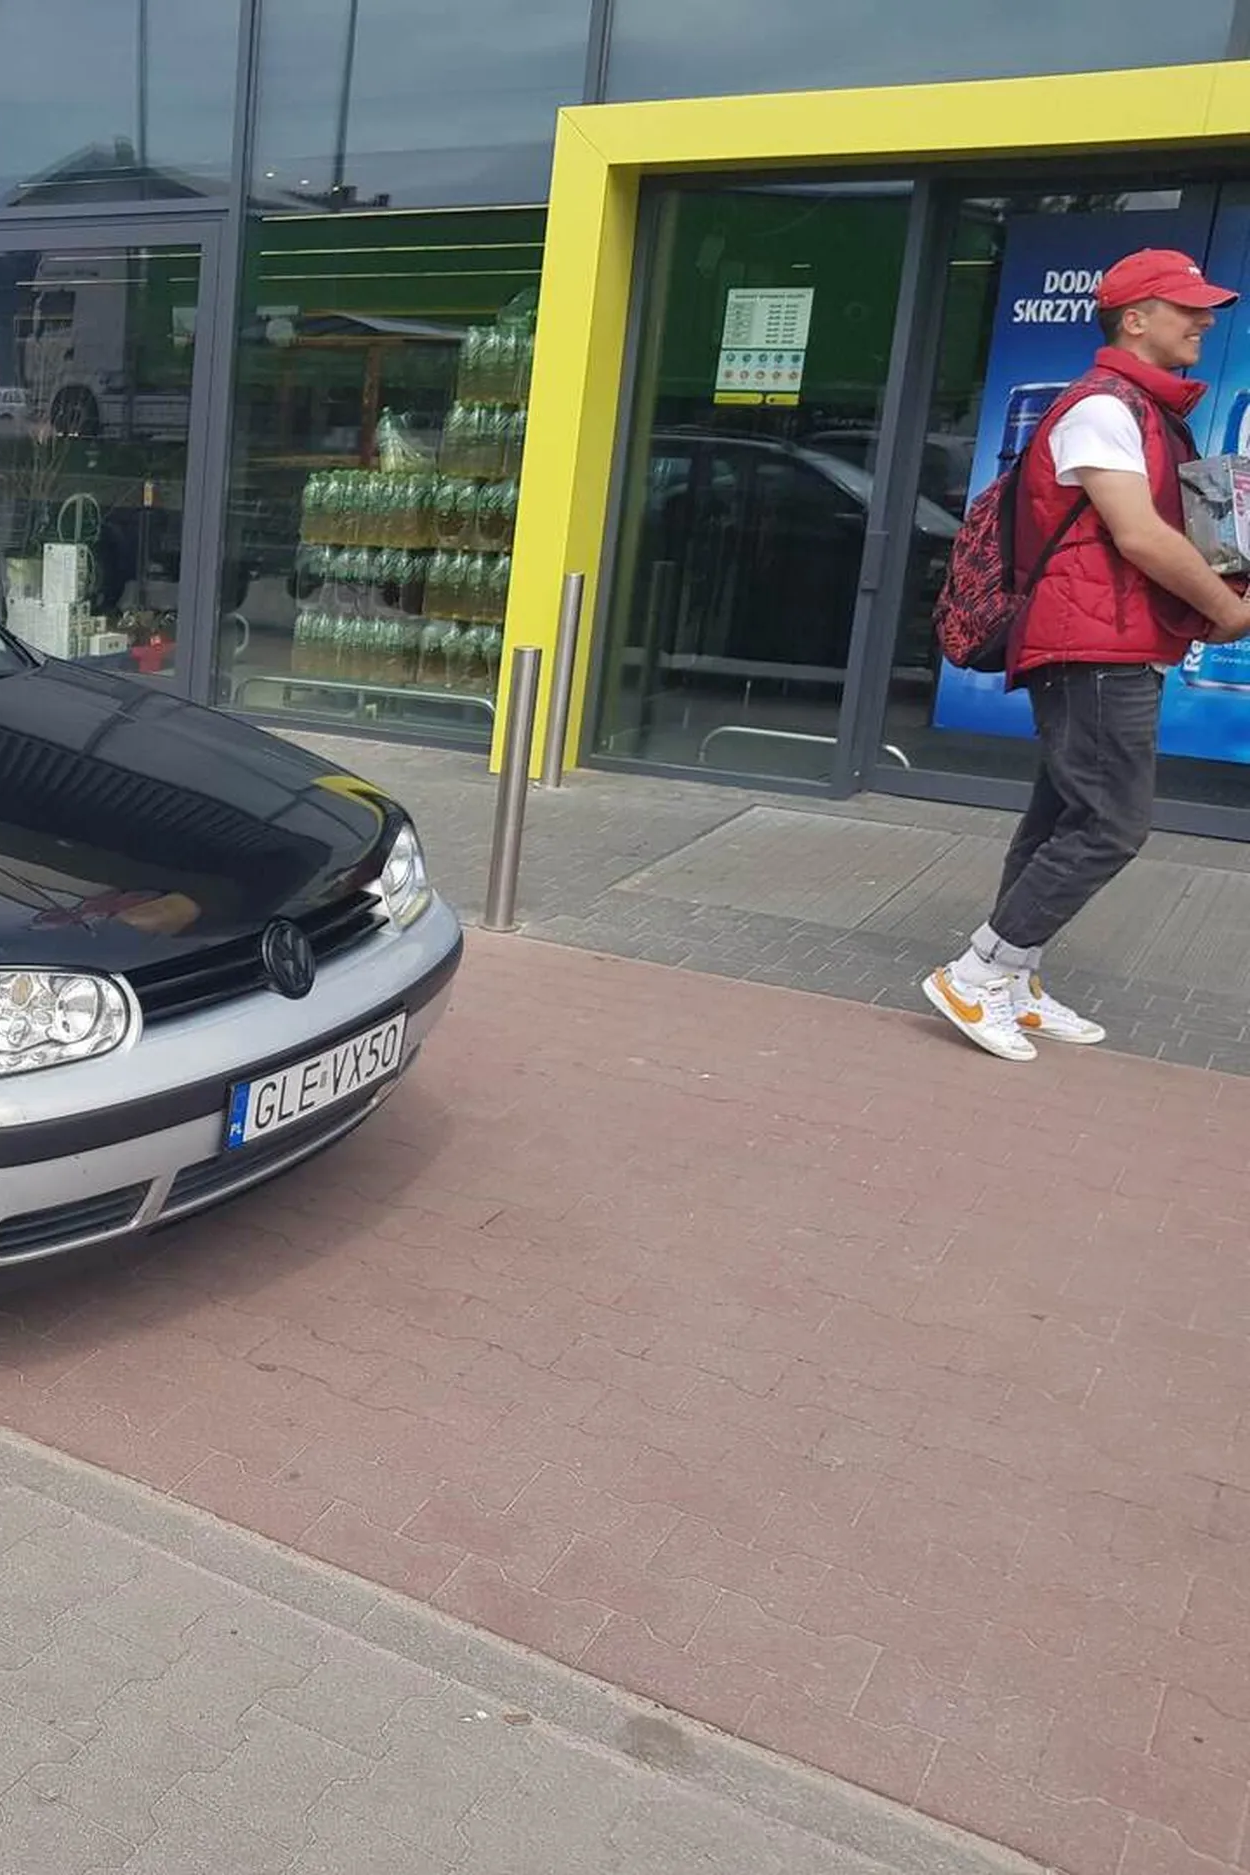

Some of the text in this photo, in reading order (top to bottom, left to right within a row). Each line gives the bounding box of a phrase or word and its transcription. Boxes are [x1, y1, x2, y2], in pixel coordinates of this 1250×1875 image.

[1043, 269, 1103, 294] DODA
[1012, 298, 1097, 323] SKRZYY
[1183, 639, 1207, 672] Re
[254, 1023, 398, 1130] GLE VX50
